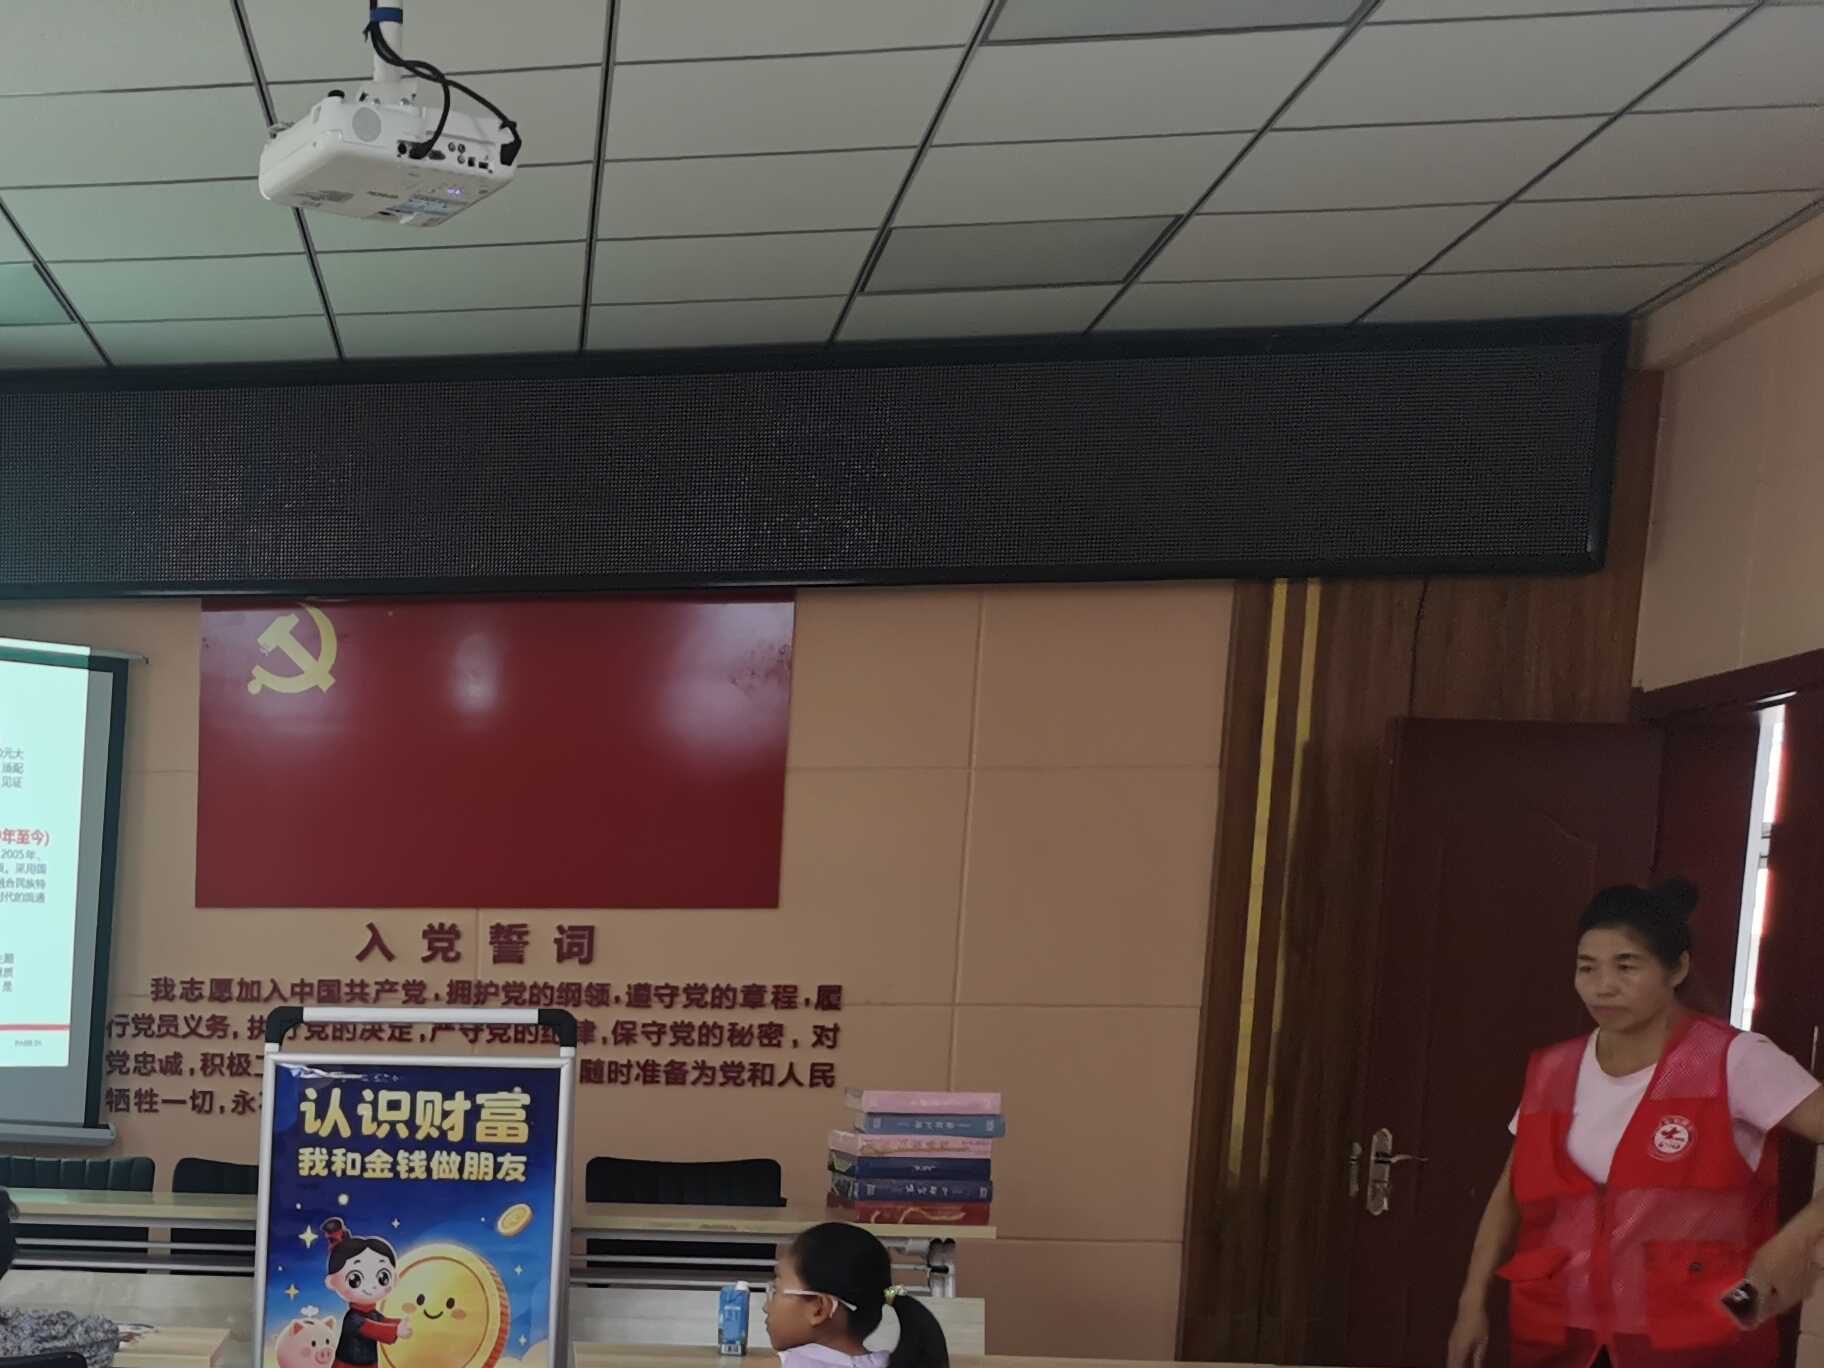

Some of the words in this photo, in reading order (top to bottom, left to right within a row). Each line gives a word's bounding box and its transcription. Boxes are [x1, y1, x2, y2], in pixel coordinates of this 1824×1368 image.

[355, 922, 597, 967] 入党誓词
[299, 1087, 532, 1144] 认识财富
[297, 1146, 528, 1183] 我和金钱做朋友
